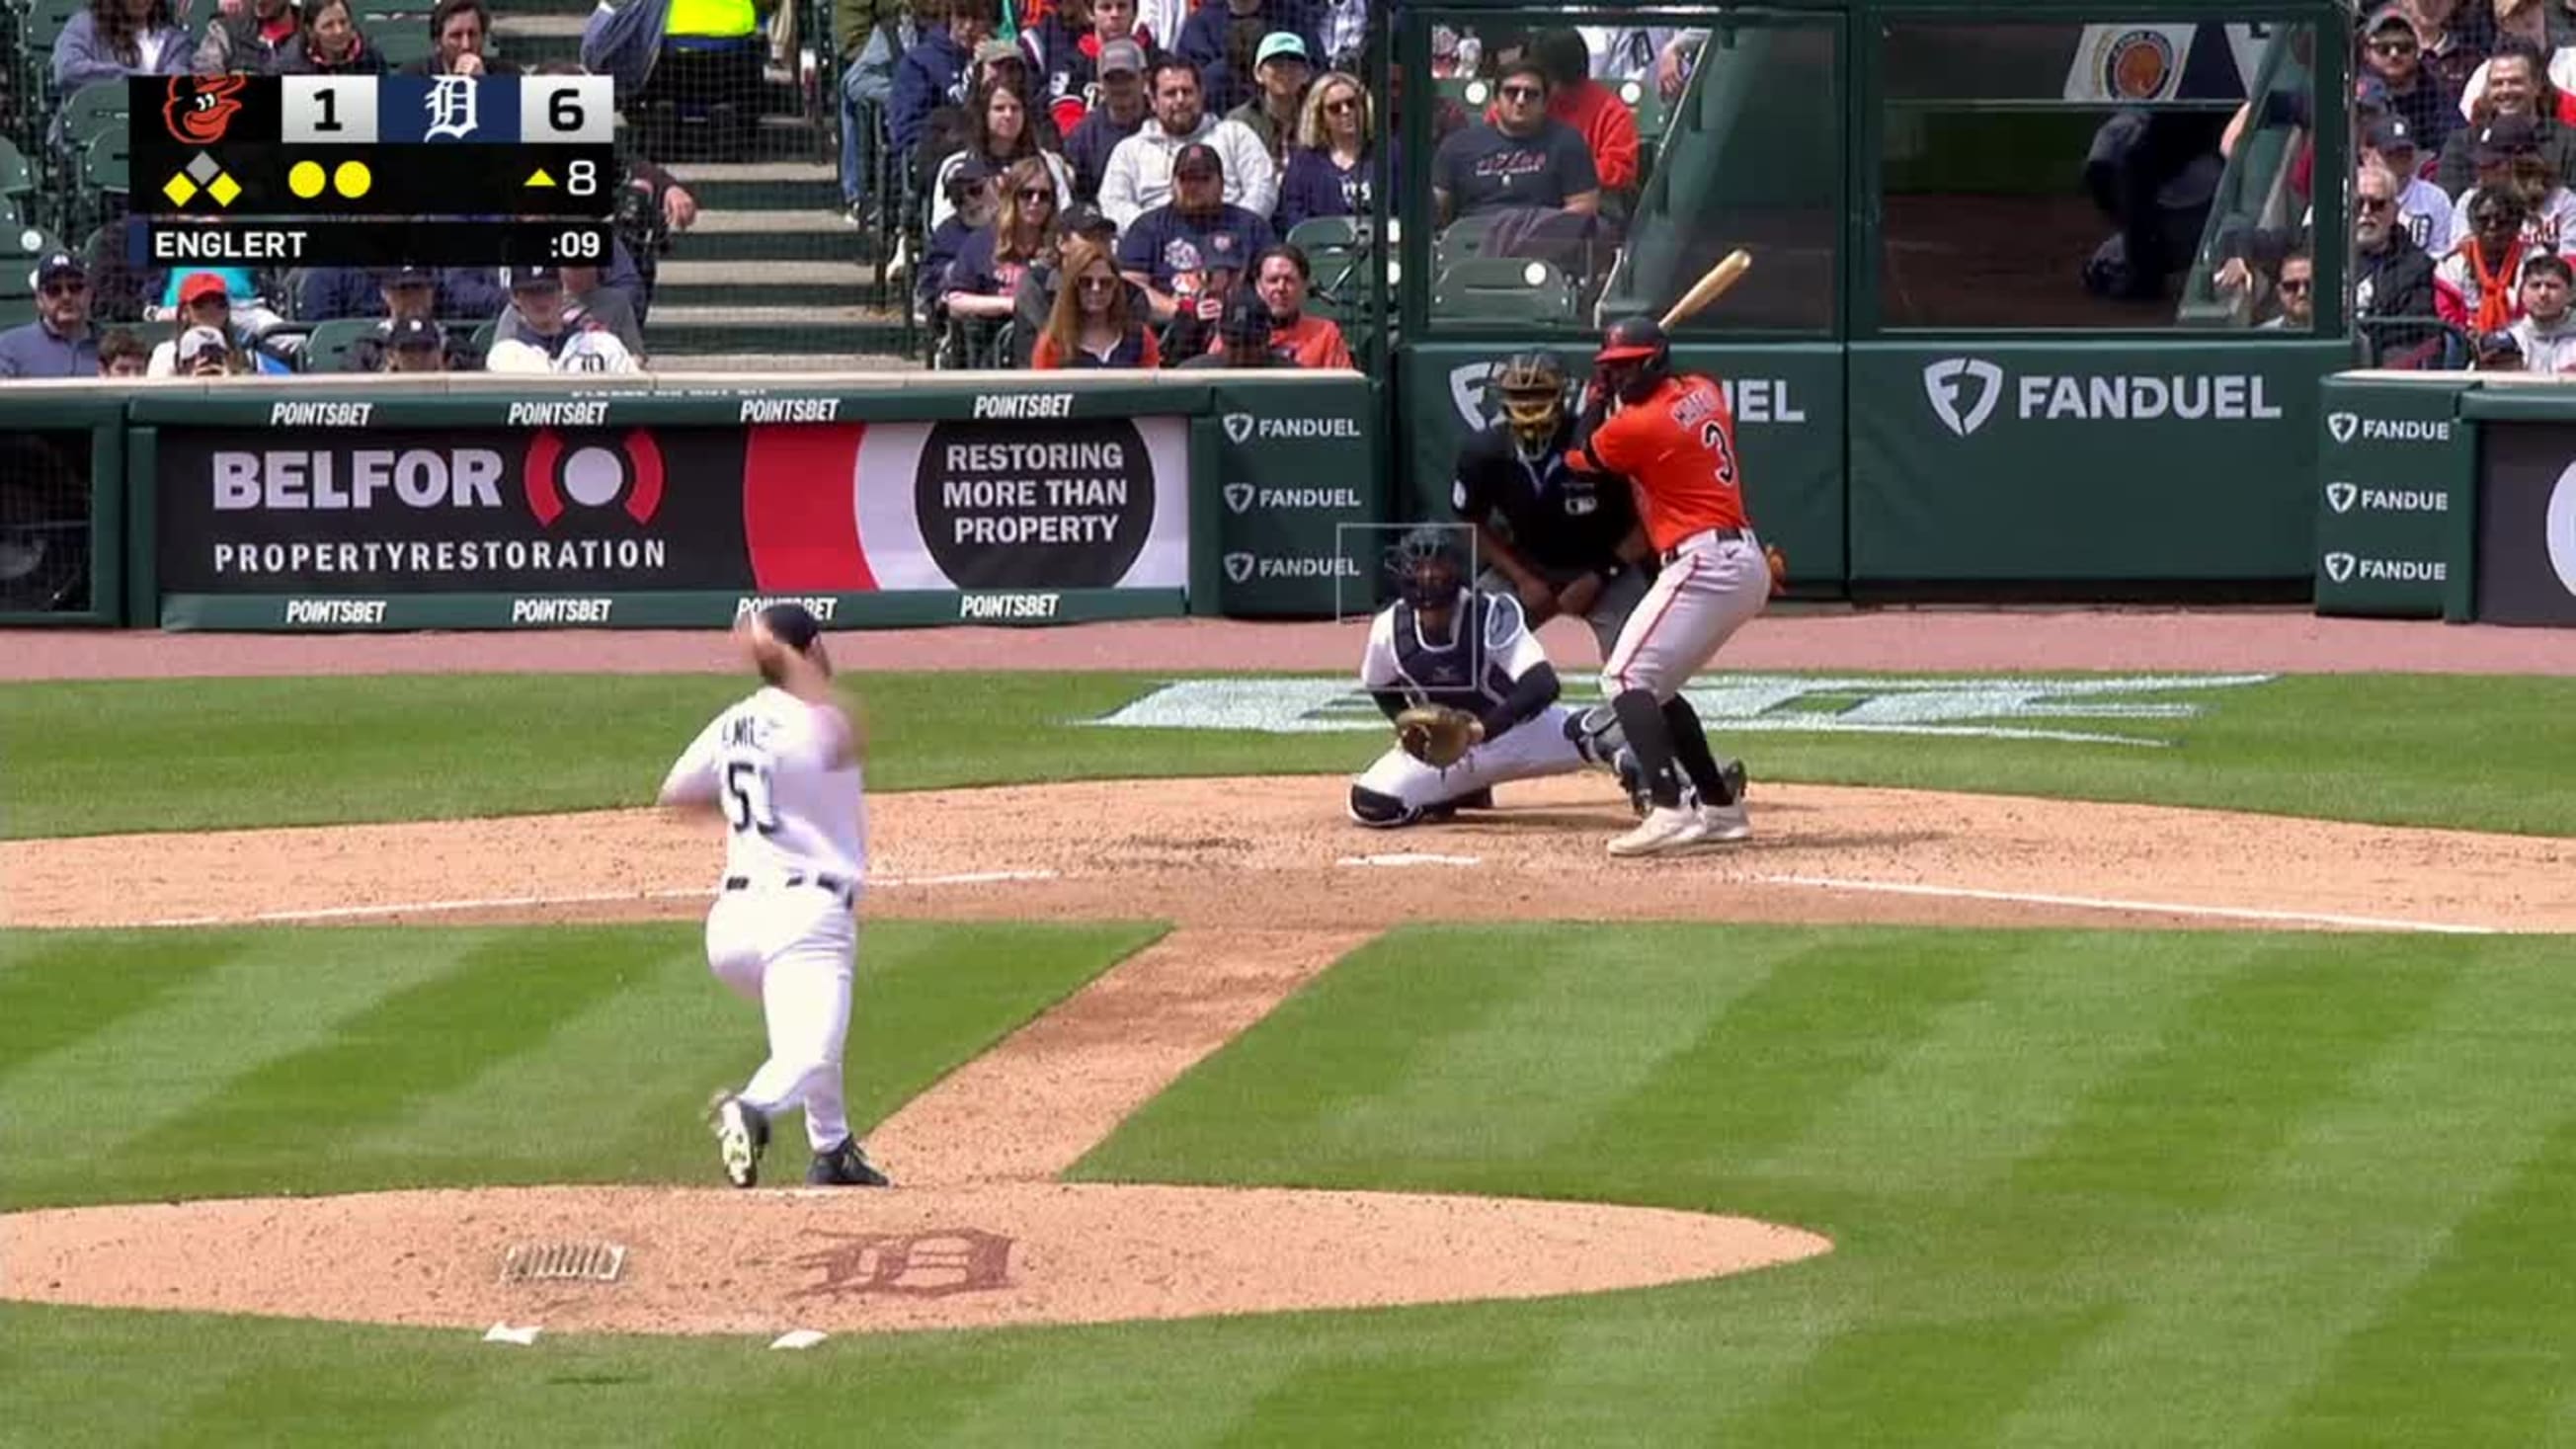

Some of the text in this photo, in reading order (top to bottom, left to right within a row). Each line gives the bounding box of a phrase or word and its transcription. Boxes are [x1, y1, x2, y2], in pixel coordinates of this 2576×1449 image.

[973, 392, 1074, 419] POINTSBET
[2019, 375, 2283, 420] FANDUEL
[271, 402, 373, 426] POINTSBET
[509, 402, 609, 426] POINTSBET
[740, 398, 841, 423] POINTSBET
[1259, 419, 1361, 438] FANDUEL
[2363, 419, 2450, 441] FANDUE
[946, 443, 1124, 472] RESTORING
[1701, 421, 1735, 485] 3
[212, 449, 503, 510] BELFOR
[943, 479, 1127, 509] MORE THAN
[1259, 488, 1362, 508] FANDUEL
[2361, 489, 2448, 511] FANDUE
[955, 514, 1119, 544] PROPERTY
[214, 539, 666, 572] PROPERTYRESTORATION
[1259, 558, 1362, 578] FANDUEL
[2359, 559, 2447, 581] FANDUE
[286, 600, 387, 623] POINTSBET
[512, 599, 612, 622] POINTSBET
[736, 597, 839, 621] POBET
[960, 594, 1060, 618] POINTSBET
